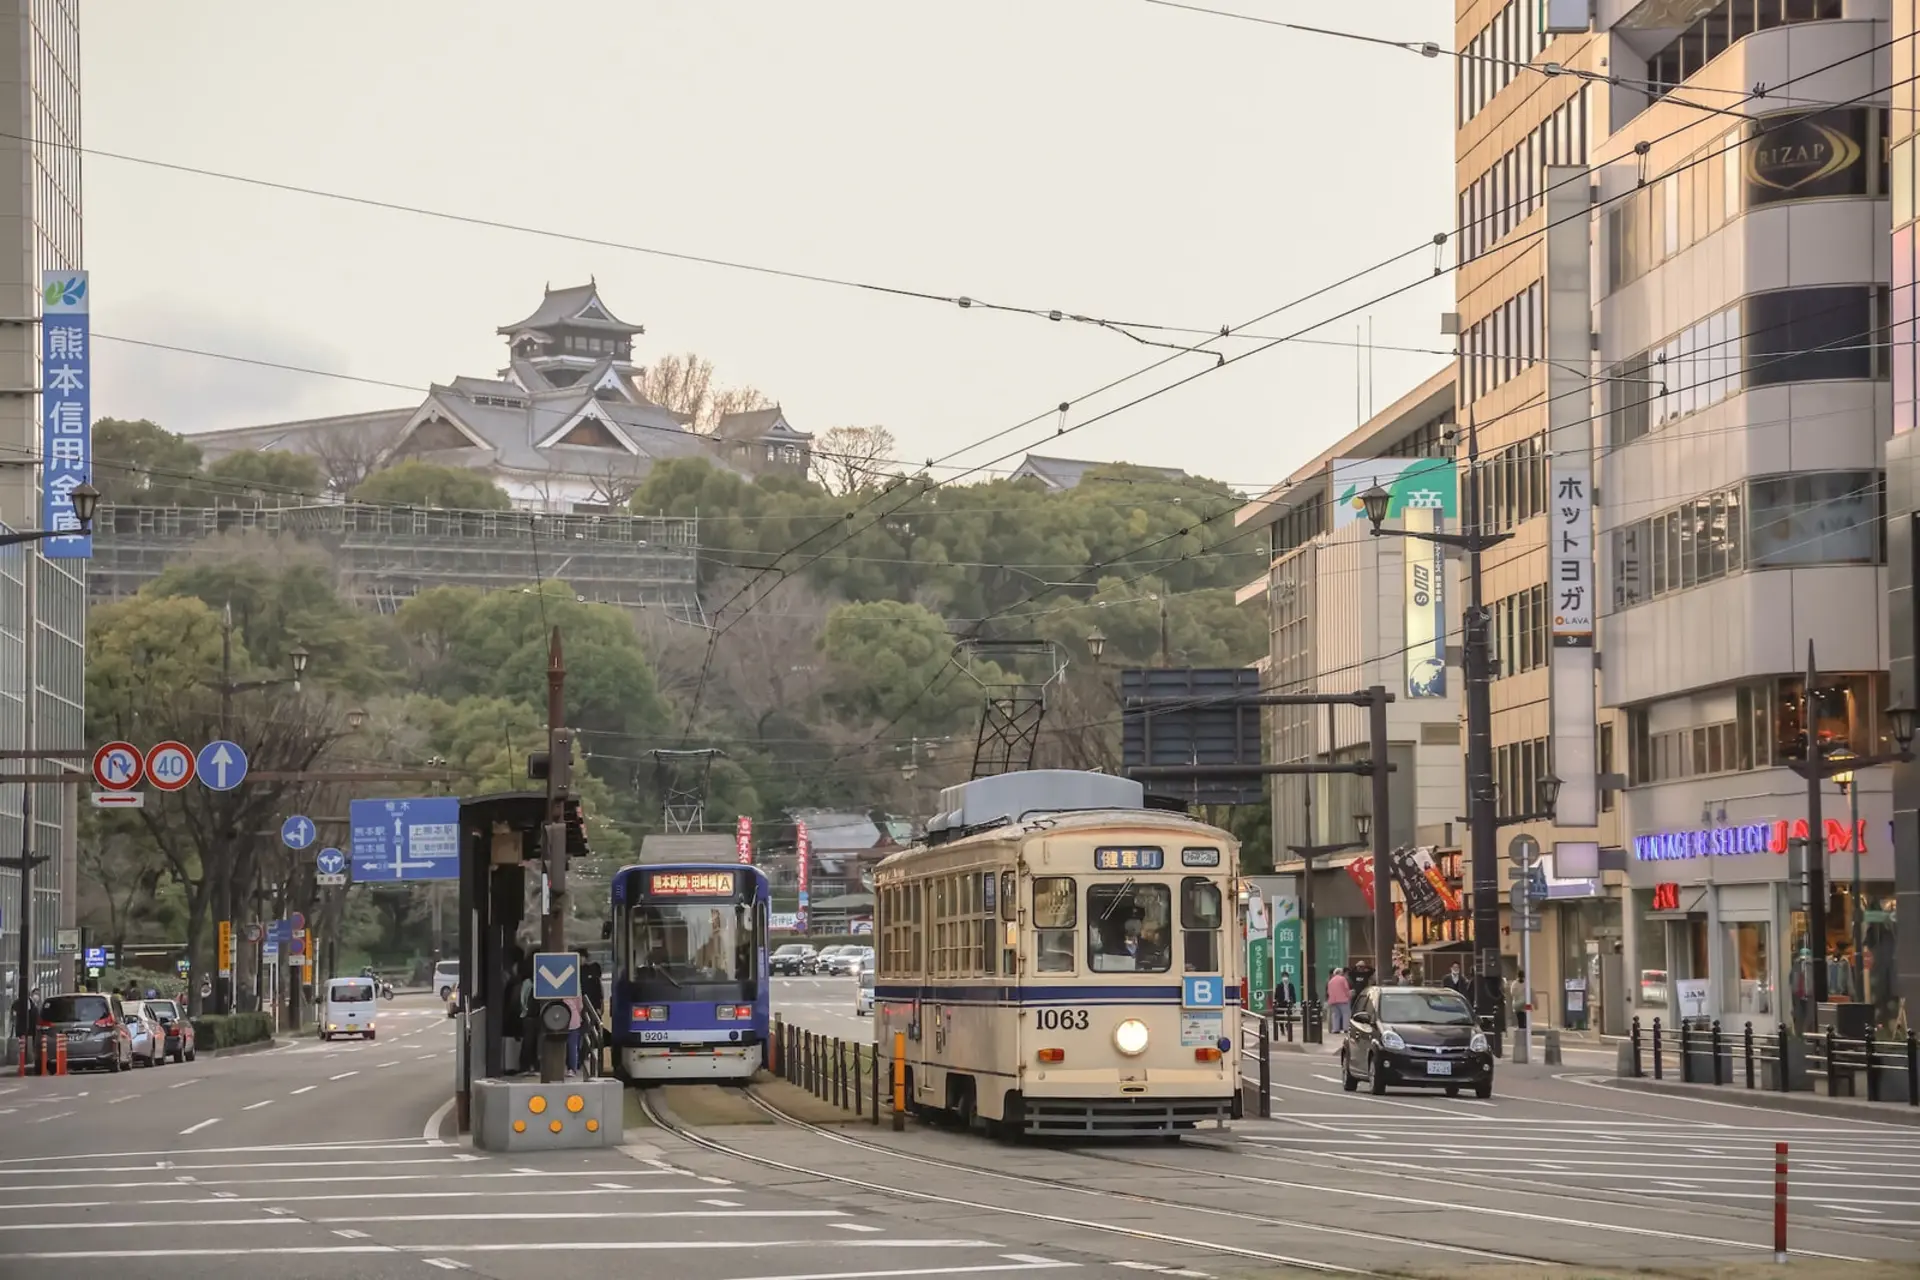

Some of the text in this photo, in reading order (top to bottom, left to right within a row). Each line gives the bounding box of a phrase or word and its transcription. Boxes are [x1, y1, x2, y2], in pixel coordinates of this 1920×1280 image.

[1759, 143, 1825, 165] RIZAP
[1558, 476, 1584, 611] ホットヨガ
[1414, 563, 1430, 607] HIS
[1565, 617, 1590, 625] LAVA
[157, 756, 184, 777] 40
[1634, 831, 1697, 861] VINTAGE
[1711, 823, 1771, 857] SELECT
[1101, 850, 1159, 868] 健軍町
[1193, 980, 1213, 1003] B
[1683, 989, 1706, 999] JAM
[1036, 1009, 1090, 1030] 1063
[644, 1031, 669, 1041] 9204
